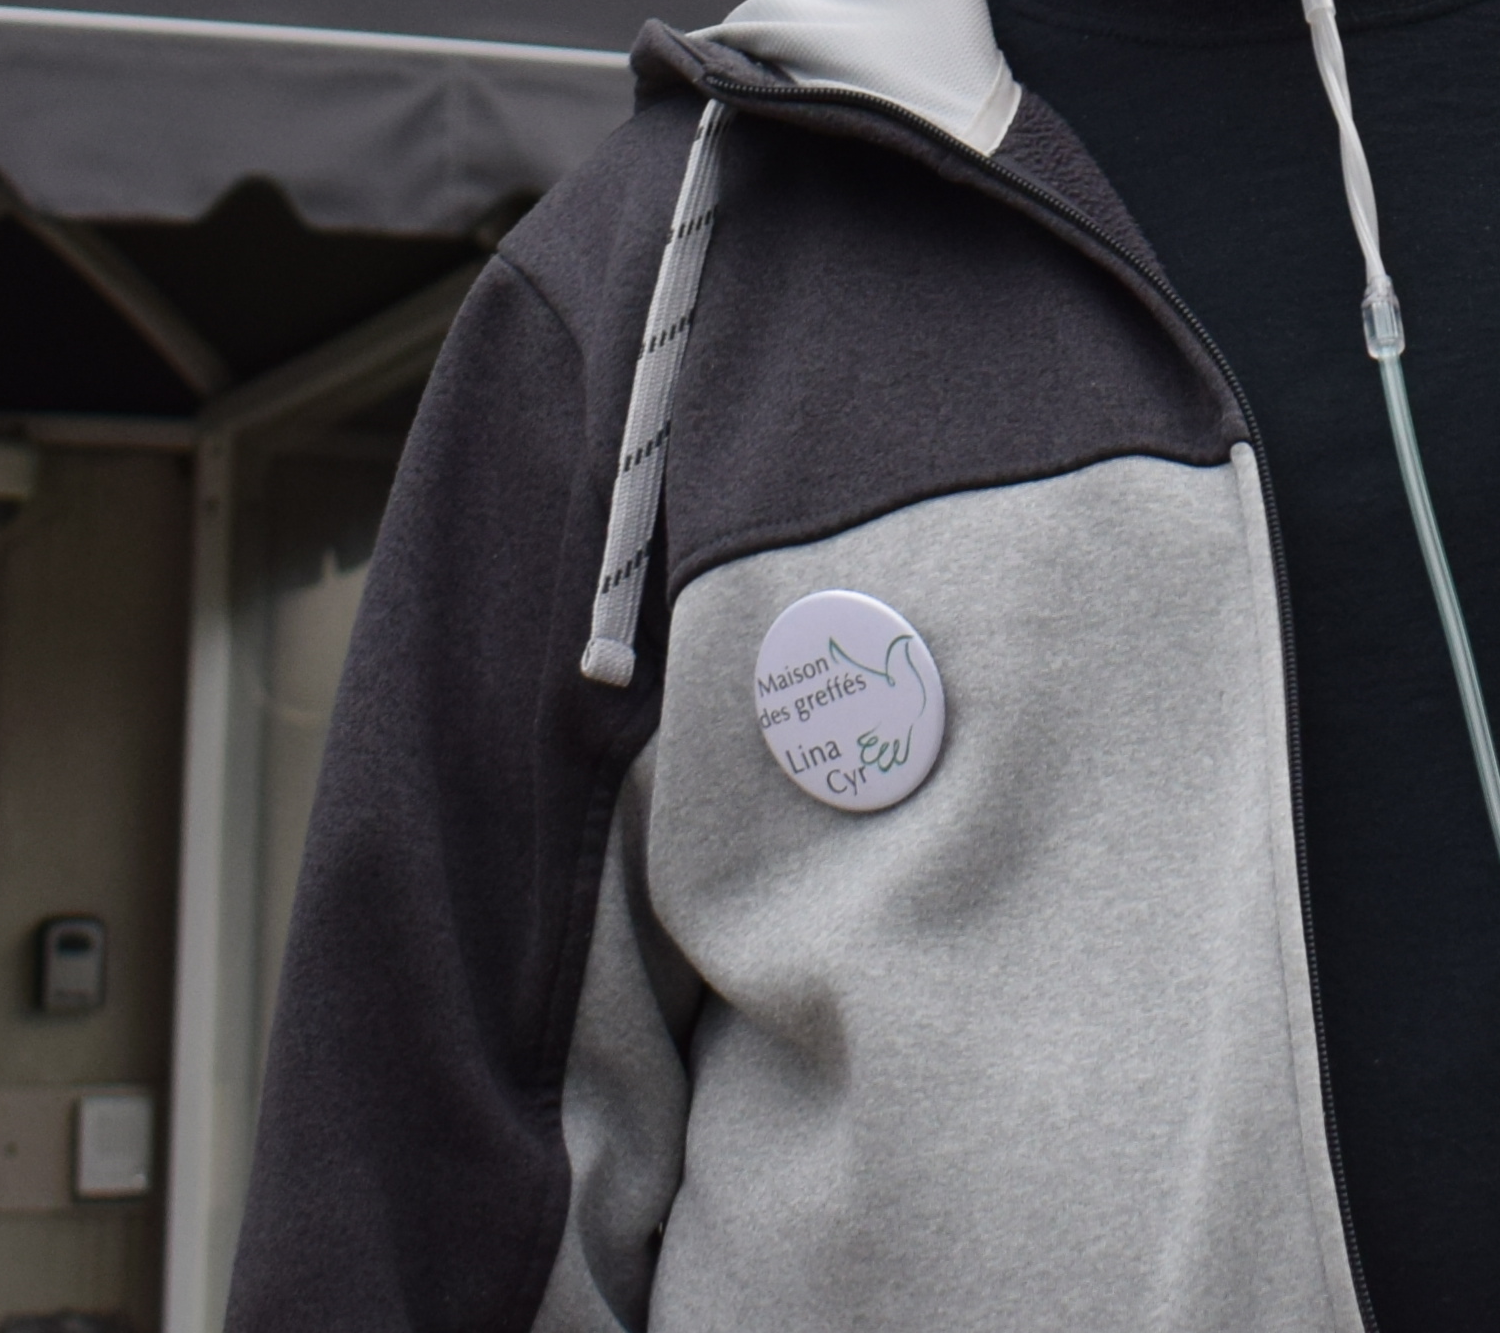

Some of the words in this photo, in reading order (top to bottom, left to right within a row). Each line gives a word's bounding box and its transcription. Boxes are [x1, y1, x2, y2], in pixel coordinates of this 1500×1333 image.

[757, 656, 830, 698] Maison
[760, 705, 791, 730] des
[794, 673, 867, 723] greffés
[786, 739, 842, 775] Lina
[826, 765, 867, 797] Cyr
